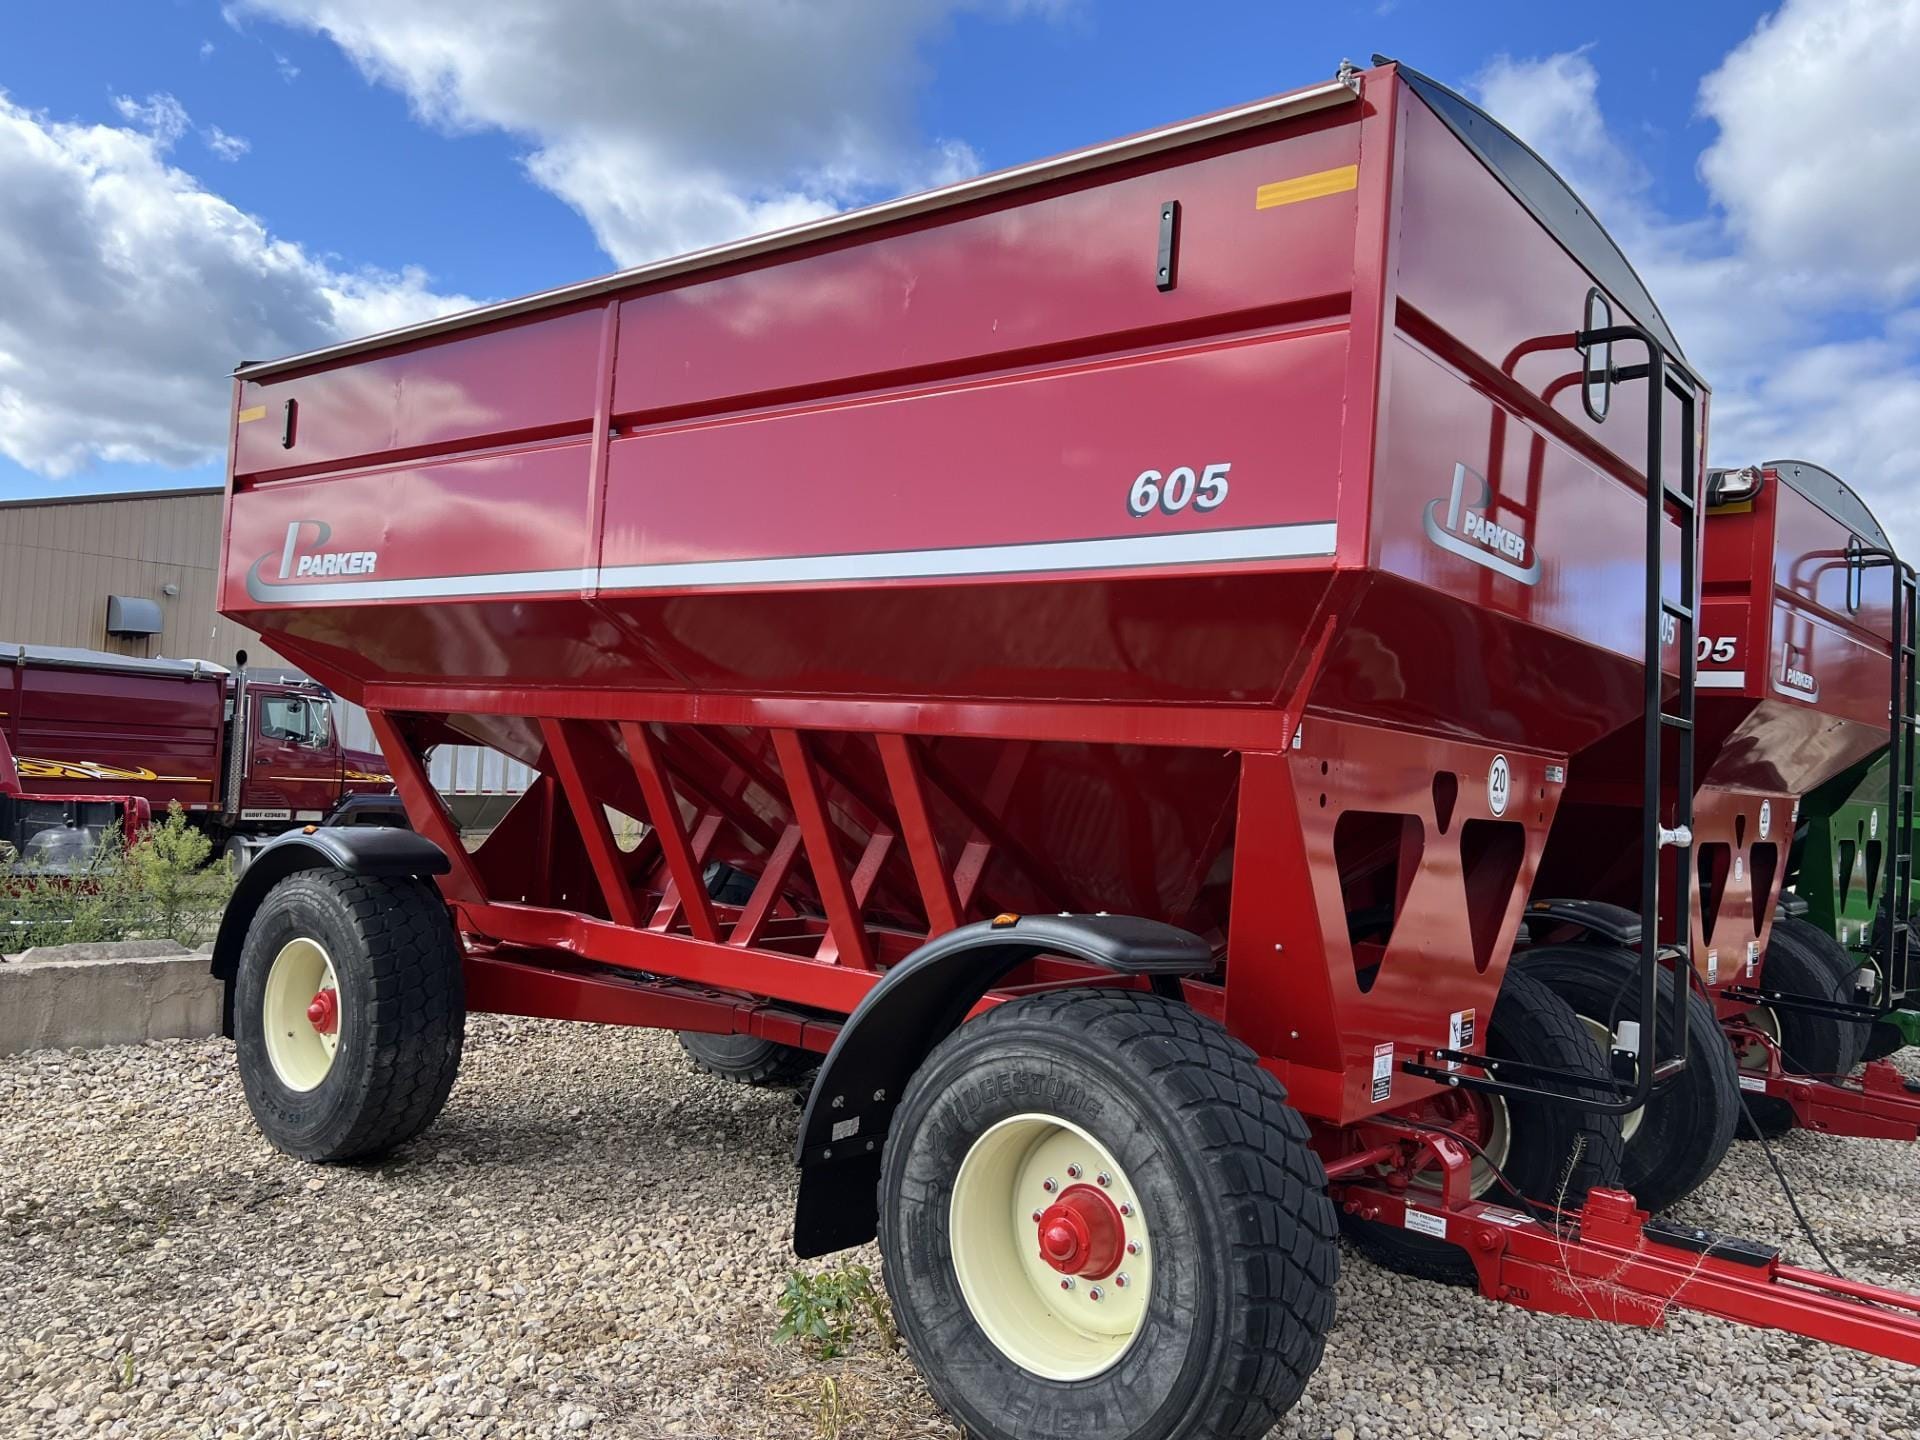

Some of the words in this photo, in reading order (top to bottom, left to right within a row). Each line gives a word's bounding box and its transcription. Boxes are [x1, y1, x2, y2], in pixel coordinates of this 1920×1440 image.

[1128, 462, 1231, 517] 605
[1463, 510, 1525, 562] PARKER
[297, 551, 377, 577] PARKER
[1661, 612, 1676, 645] 05
[1697, 636, 1737, 663] 05
[1787, 668, 1814, 690] PARKER
[1492, 767, 1506, 793] 20
[926, 1070, 1105, 1158] BRIDGESTONE
